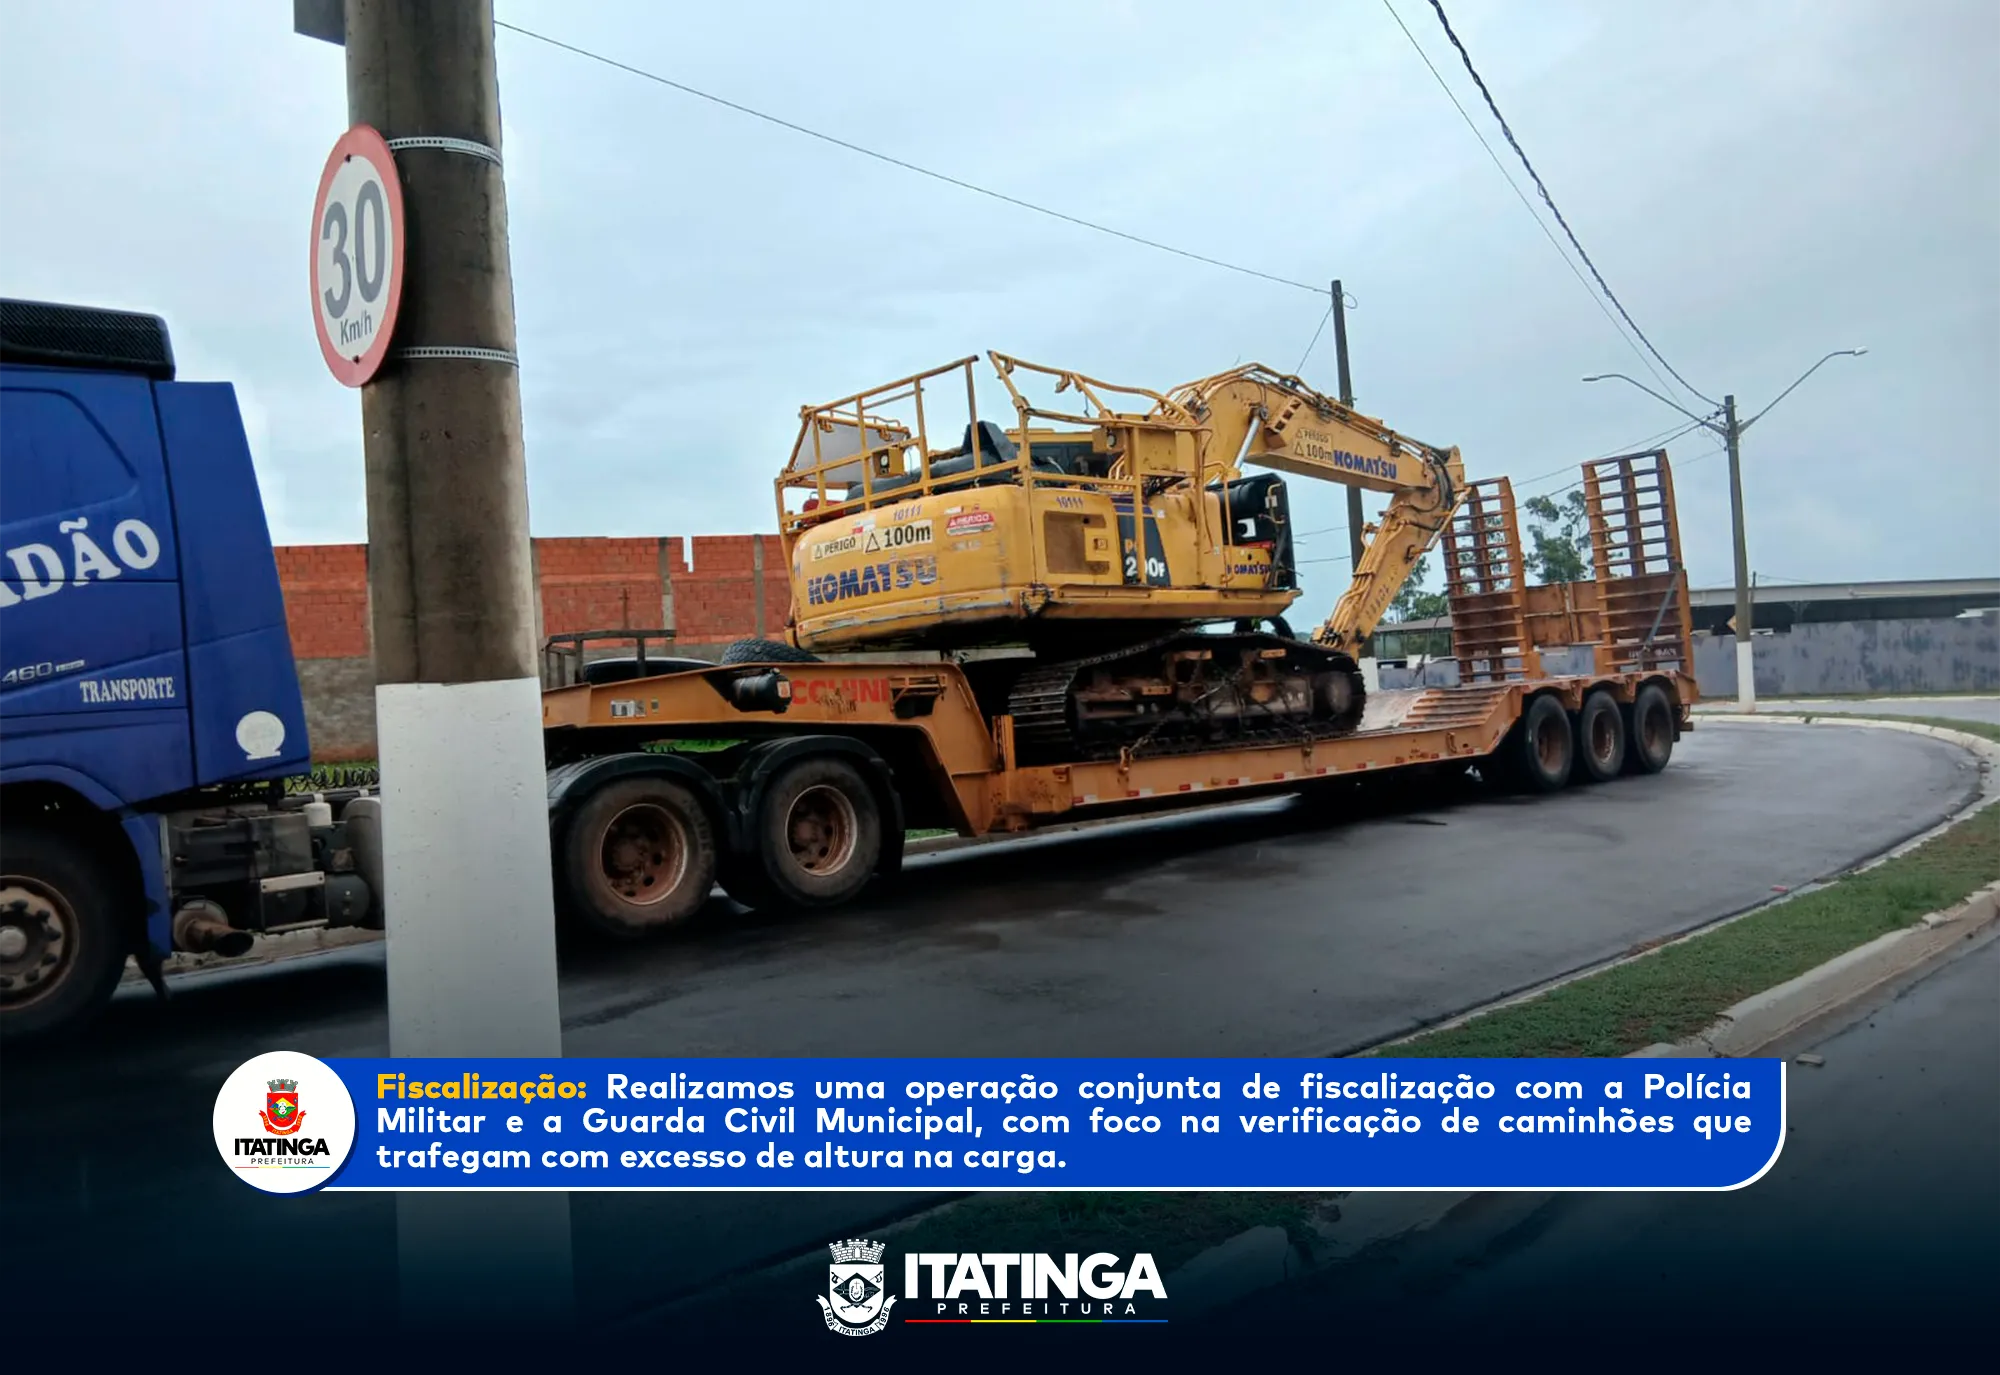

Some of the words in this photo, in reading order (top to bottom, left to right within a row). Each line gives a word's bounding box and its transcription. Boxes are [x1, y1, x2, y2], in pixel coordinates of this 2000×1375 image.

[323, 180, 385, 319] 30
[340, 310, 372, 346] Km/h
[1306, 443, 1333, 464] 100m
[1333, 449, 1397, 479] KOMATSU
[893, 504, 922, 522] 10111
[1055, 496, 1085, 508] 10111
[823, 536, 857, 556] PERIGO
[883, 524, 932, 549] 100m
[0, 517, 160, 608] DÃO
[1125, 556, 1166, 578] 20F
[807, 557, 938, 605] KOMATSU
[1, 661, 53, 683] 460
[79, 676, 175, 703] TRANSPORTE
